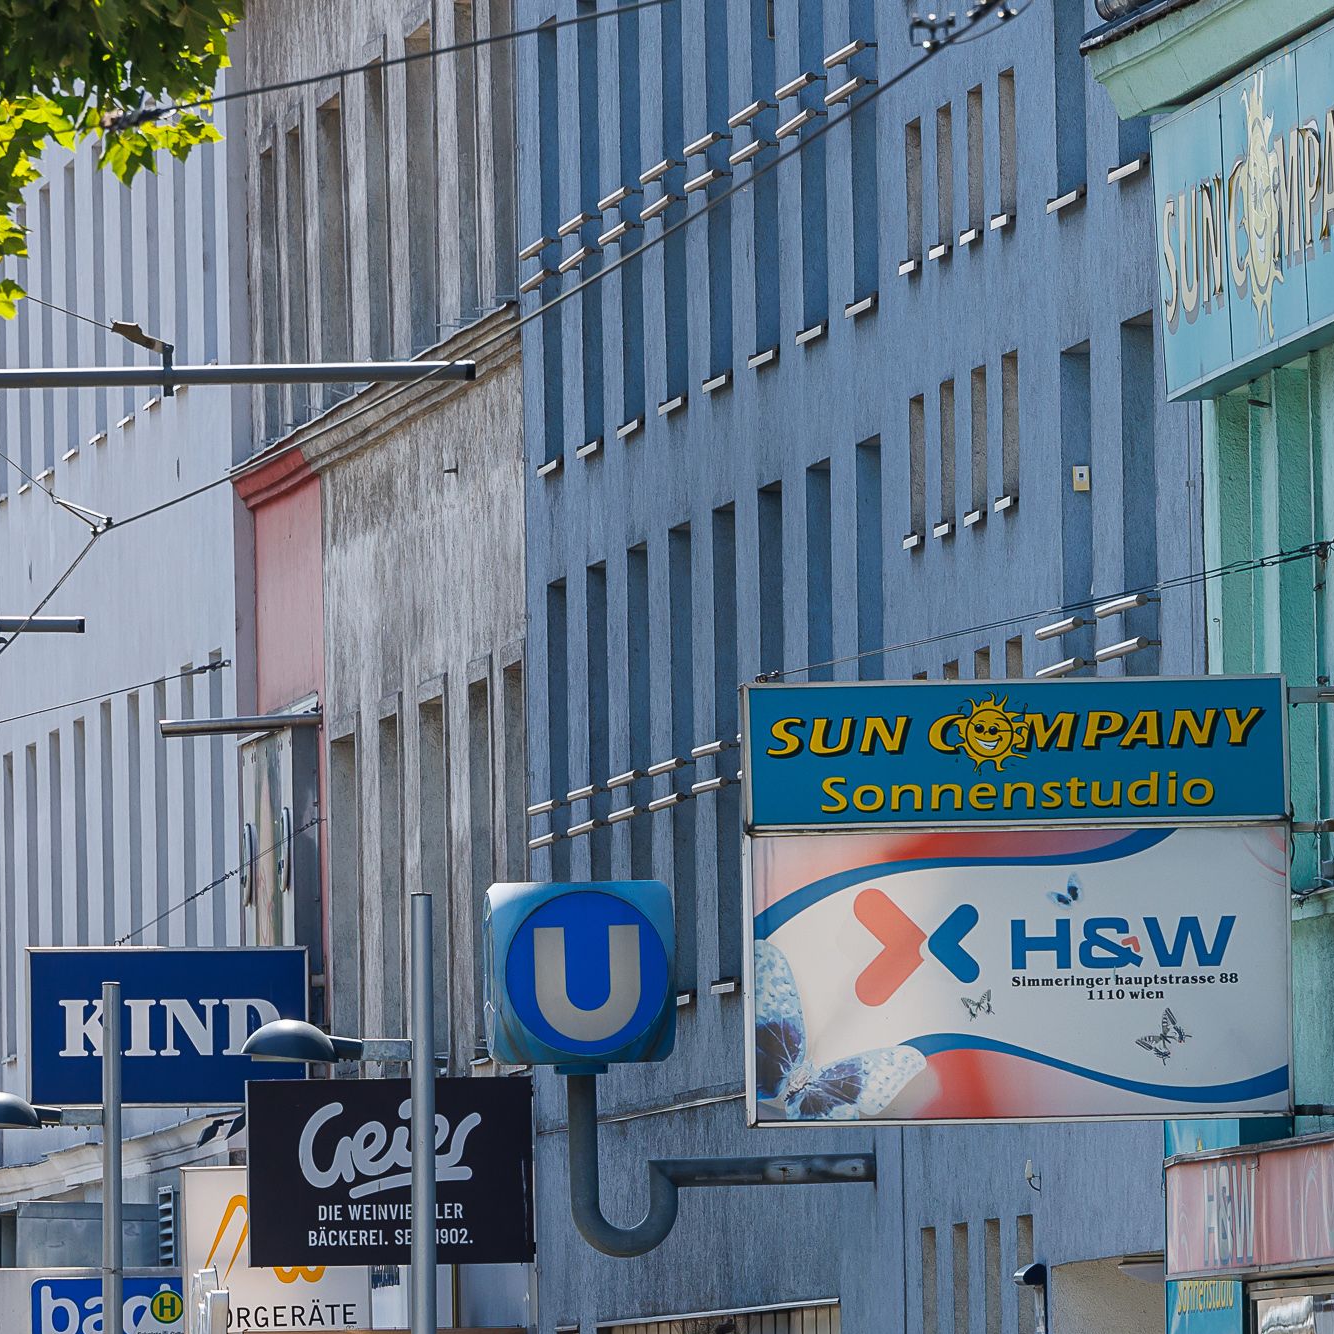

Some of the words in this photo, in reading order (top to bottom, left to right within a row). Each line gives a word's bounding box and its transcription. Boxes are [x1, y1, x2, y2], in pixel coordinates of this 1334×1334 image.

[1163, 173, 1224, 327] SUN
[768, 714, 909, 757] SUN
[820, 771, 1215, 814] Sonnenstudio
[1011, 915, 1236, 970] H&W
[533, 925, 641, 1042] U
[1012, 975, 1110, 988] Simmeringer
[1115, 973, 1215, 987] hauptstrasse
[1219, 973, 1239, 983] 88
[1087, 990, 1124, 1000] 1110
[1129, 989, 1164, 999] wien
[319, 1205, 342, 1221] DIE
[348, 1203, 463, 1221] WEINVIELER
[1203, 1159, 1256, 1267] H&W
[308, 1227, 389, 1246] BÄCKEREI.
[159, 1297, 175, 1317] H
[226, 1299, 358, 1329] RGERÄTE
